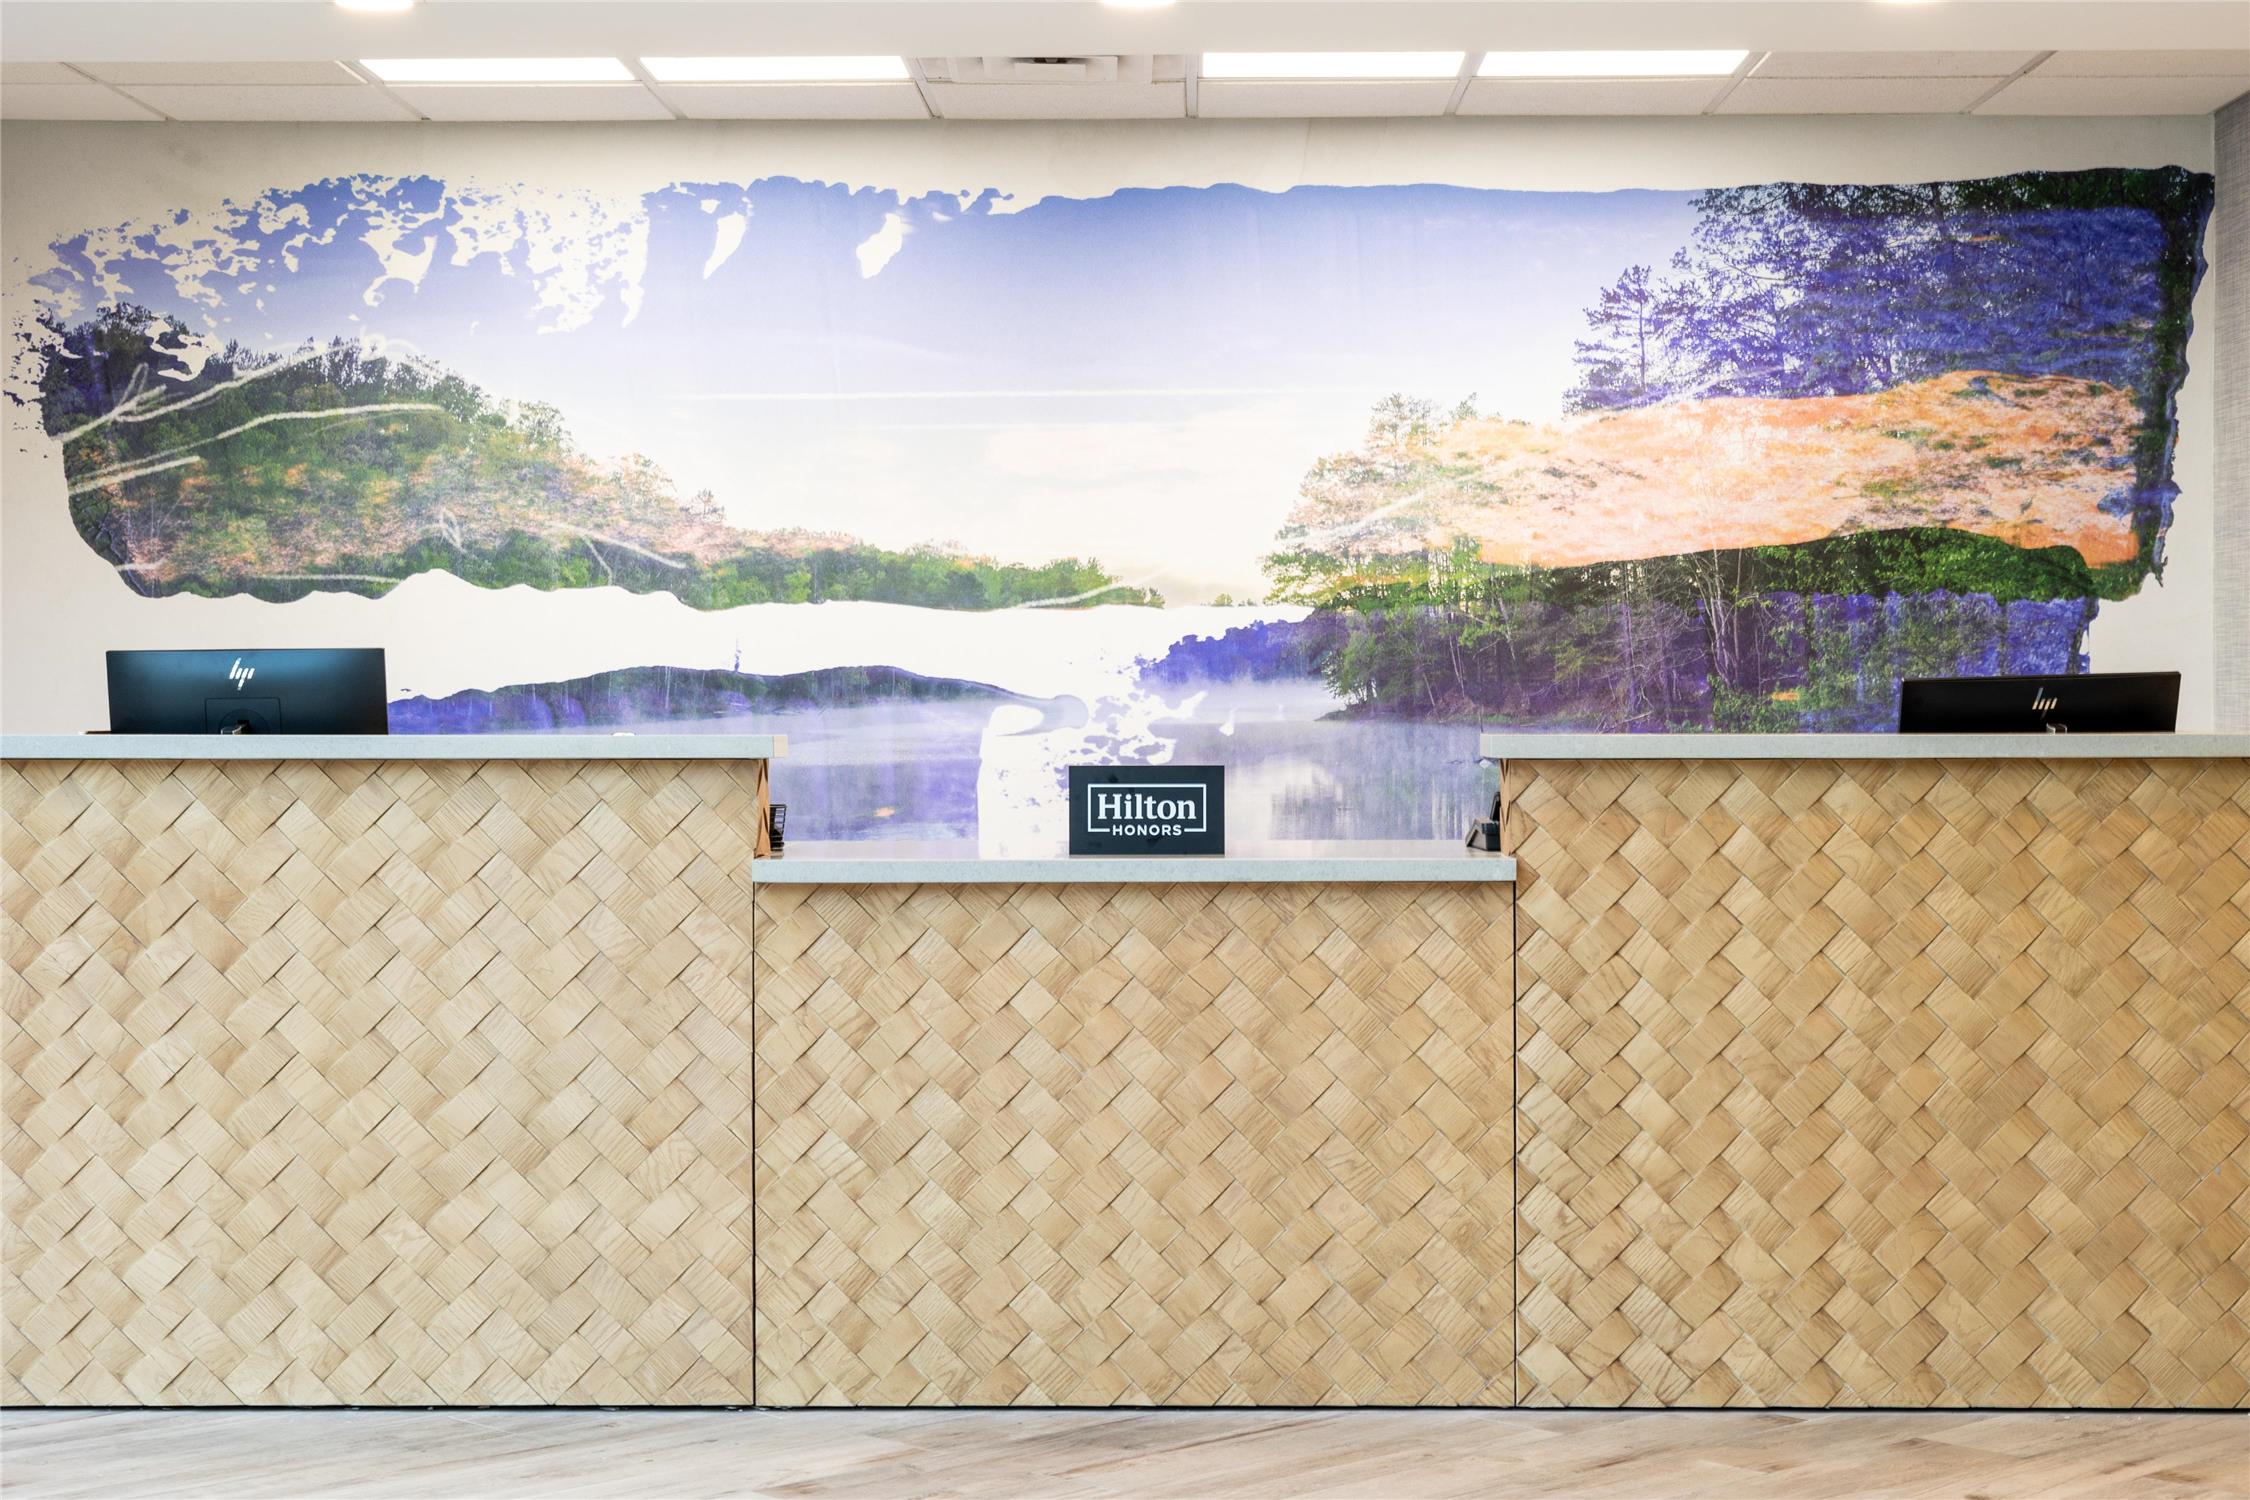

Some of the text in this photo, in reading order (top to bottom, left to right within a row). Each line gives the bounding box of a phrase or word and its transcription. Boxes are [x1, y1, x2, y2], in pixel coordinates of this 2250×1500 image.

[229, 657, 255, 691] hp
[1097, 793, 1197, 820] Hilton
[1112, 824, 1182, 836] HONORS
